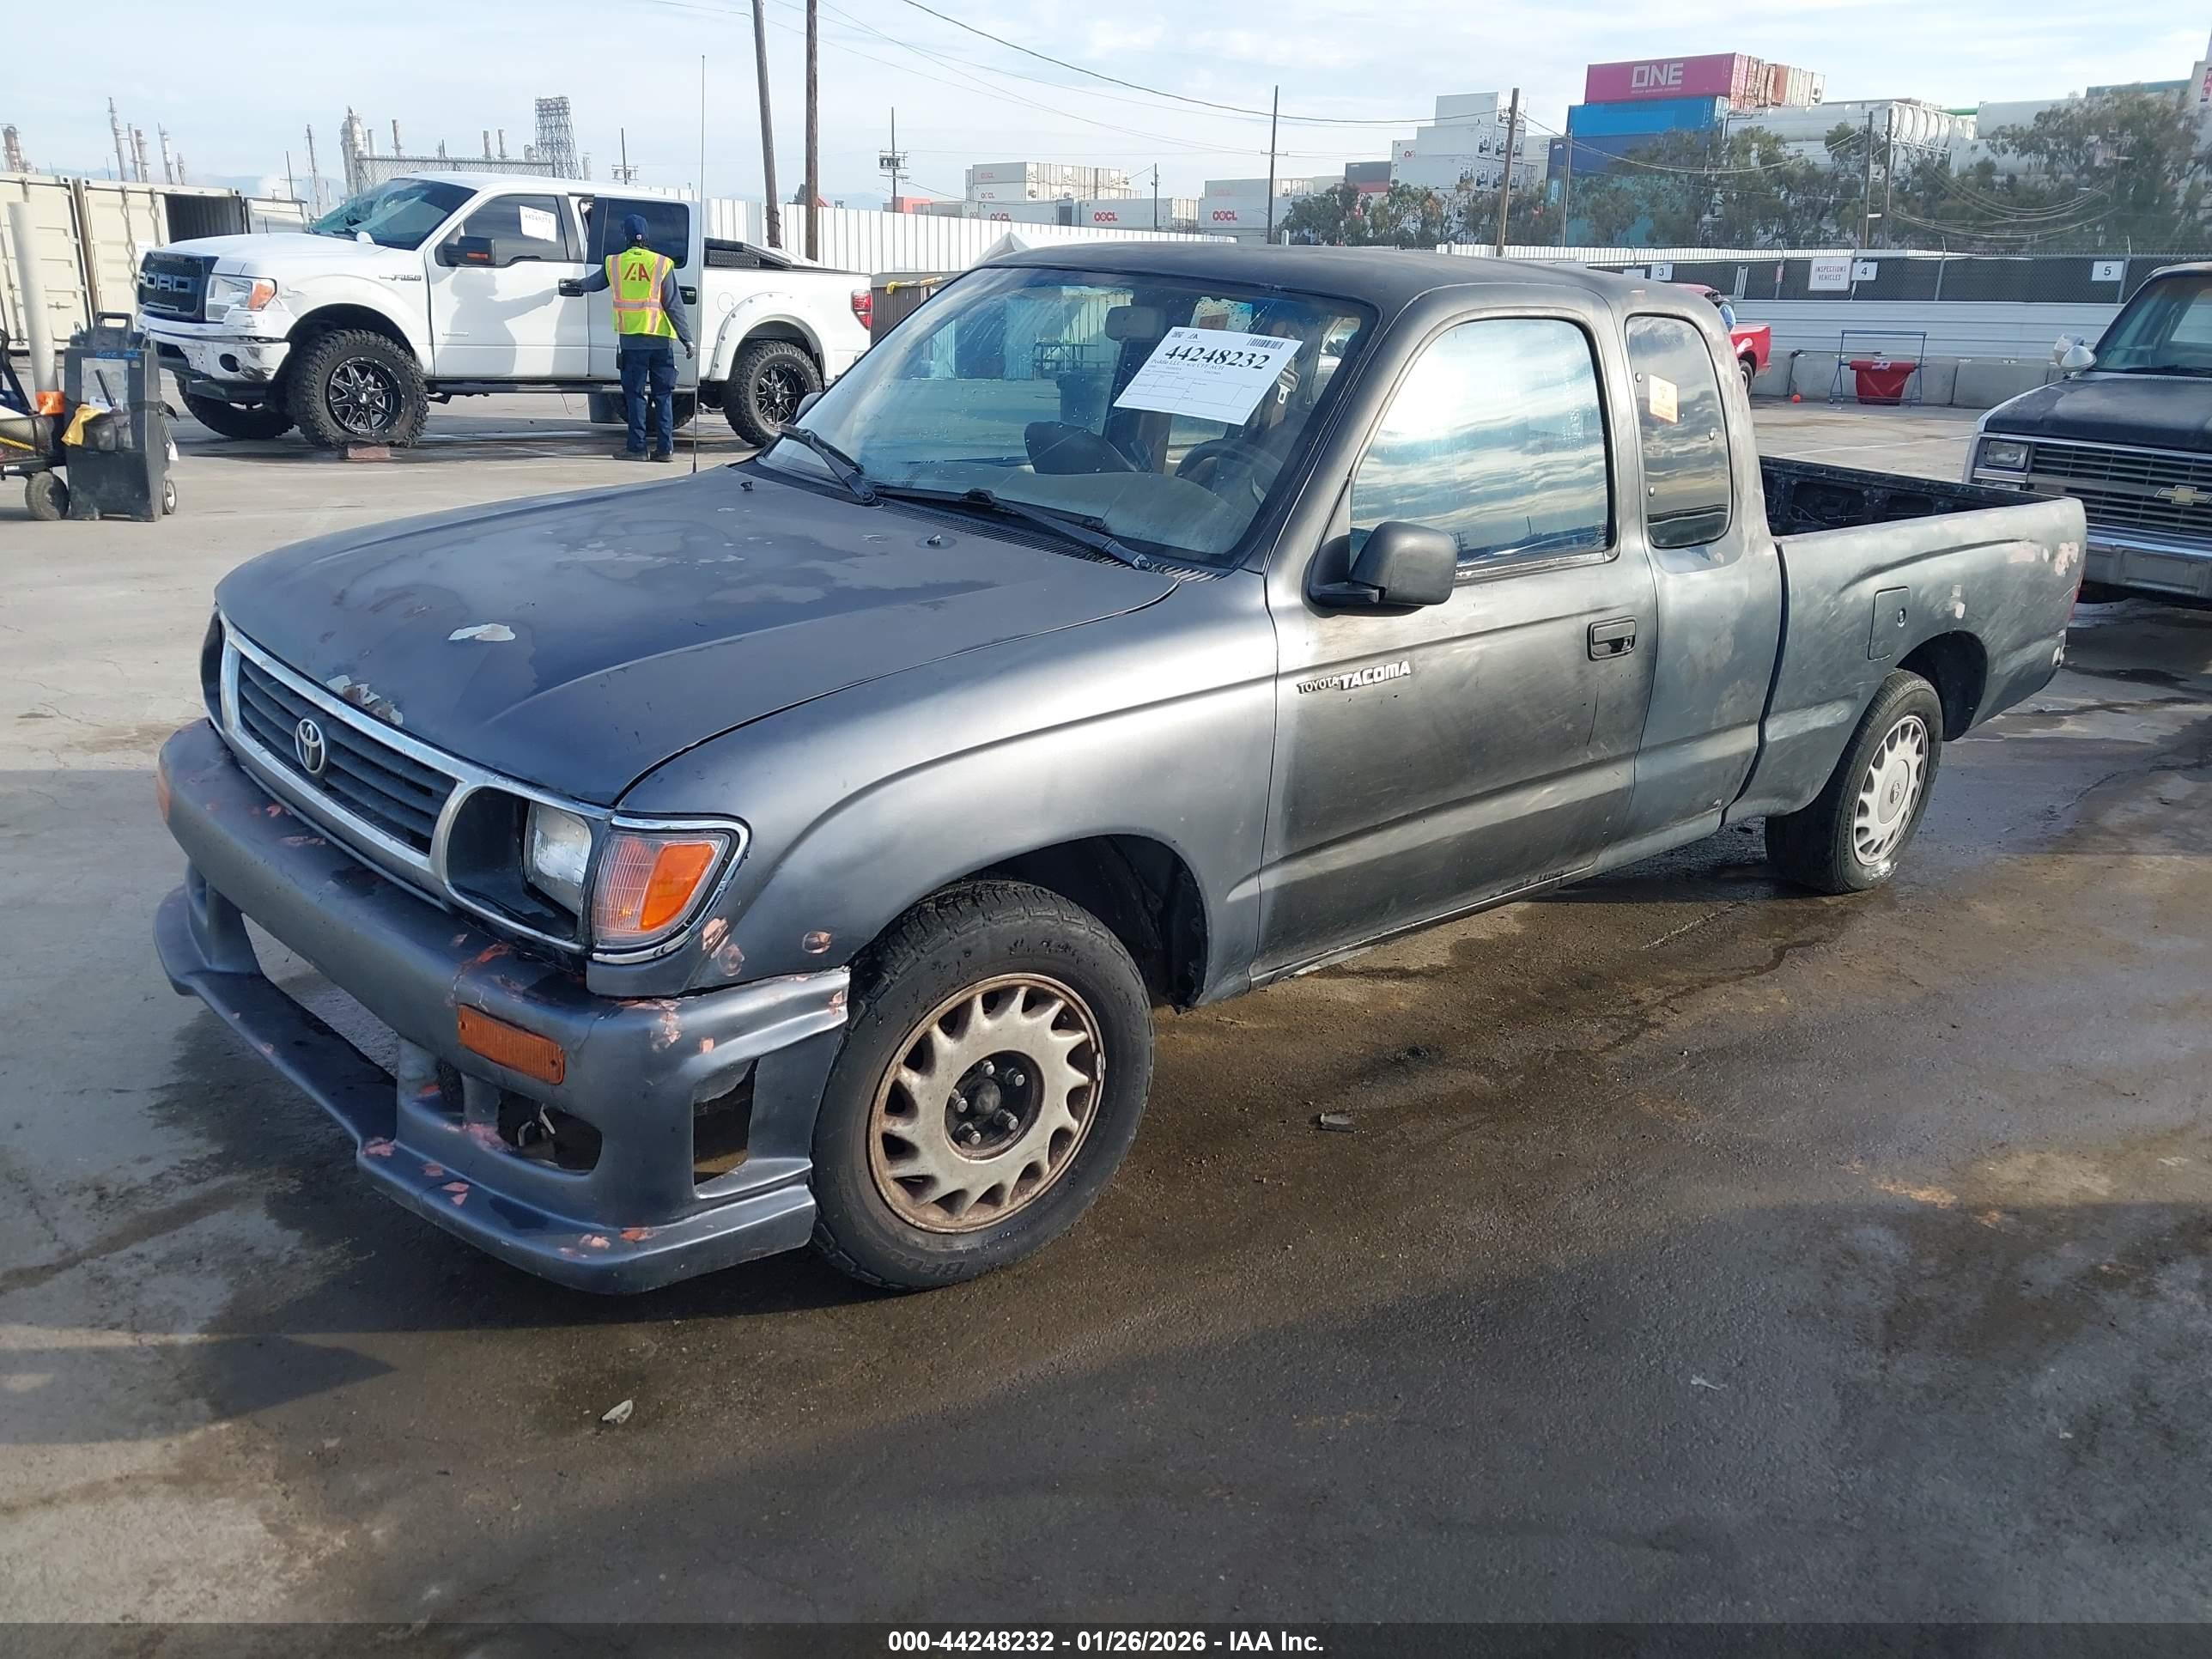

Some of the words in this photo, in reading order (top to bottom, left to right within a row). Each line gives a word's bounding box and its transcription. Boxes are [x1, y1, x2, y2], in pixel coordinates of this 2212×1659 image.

[1632, 63, 1683, 88] ONE
[1658, 267, 1664, 276] 3
[1861, 266, 1869, 276] 4
[2104, 265, 2112, 276] 5
[1165, 345, 1270, 370] 44248232
[1297, 676, 1339, 694] TOYOTA
[1339, 660, 1411, 690] TACOMA
